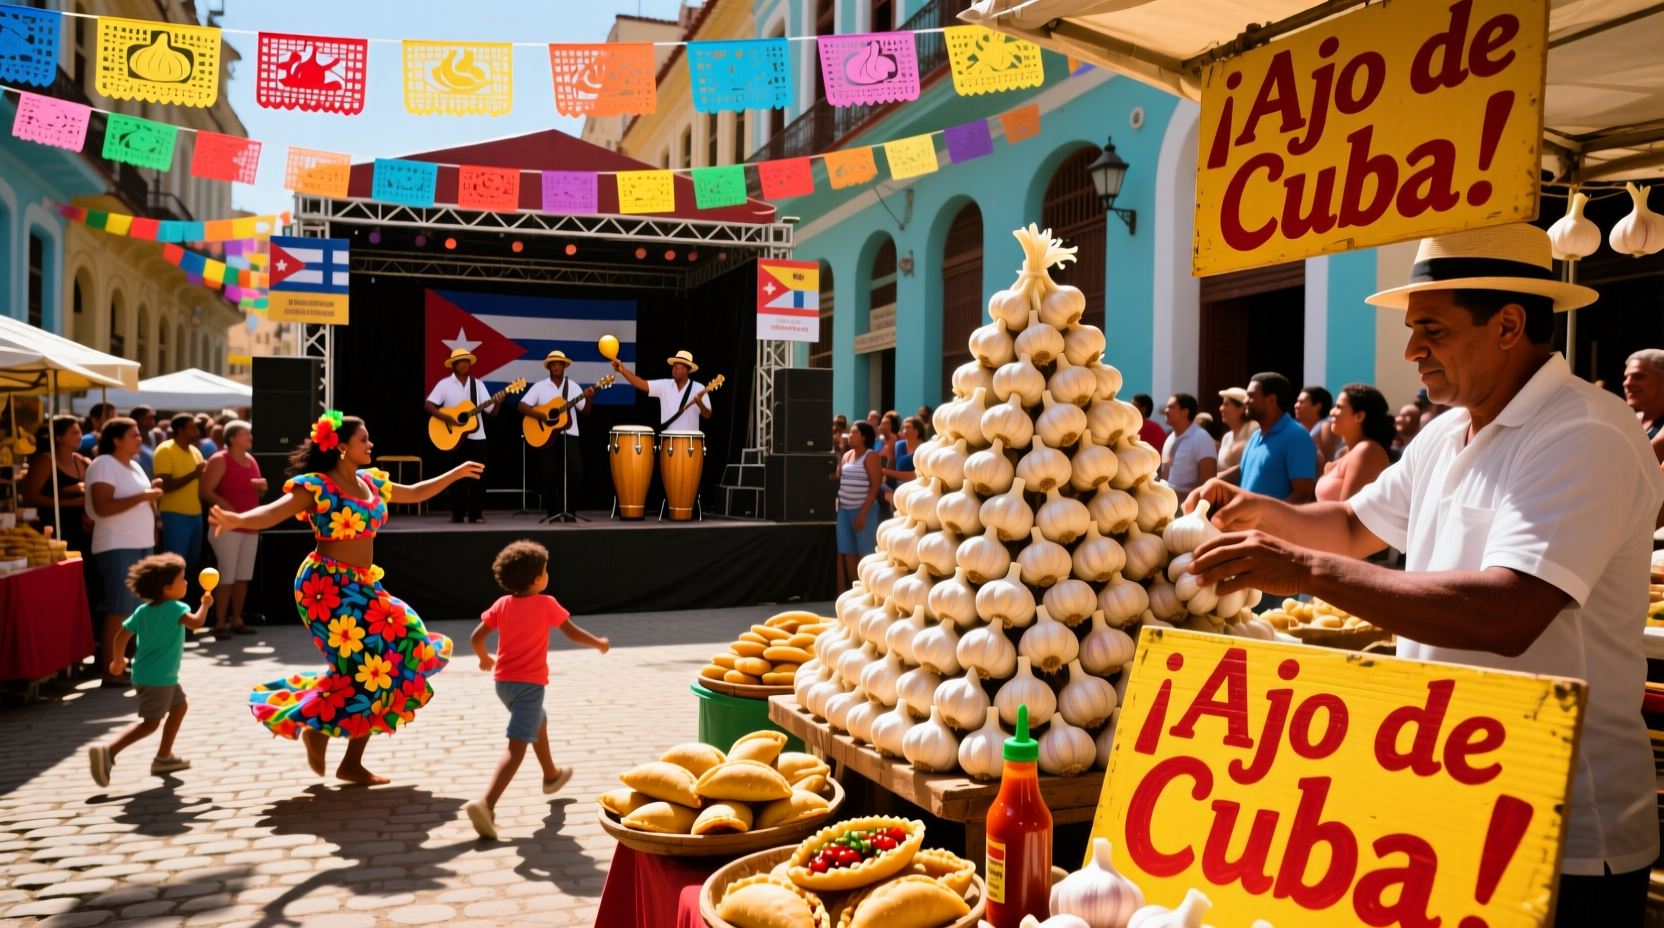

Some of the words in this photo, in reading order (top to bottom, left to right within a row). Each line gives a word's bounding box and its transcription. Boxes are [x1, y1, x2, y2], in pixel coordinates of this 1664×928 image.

[1207, 36, 1386, 170] ¡Ajo
[1410, 0, 1520, 95] de
[1220, 90, 1516, 252] Cuba!
[1134, 648, 1349, 785] ¡Ajo
[1375, 679, 1506, 786] de
[1125, 756, 1534, 928] Cuba!
